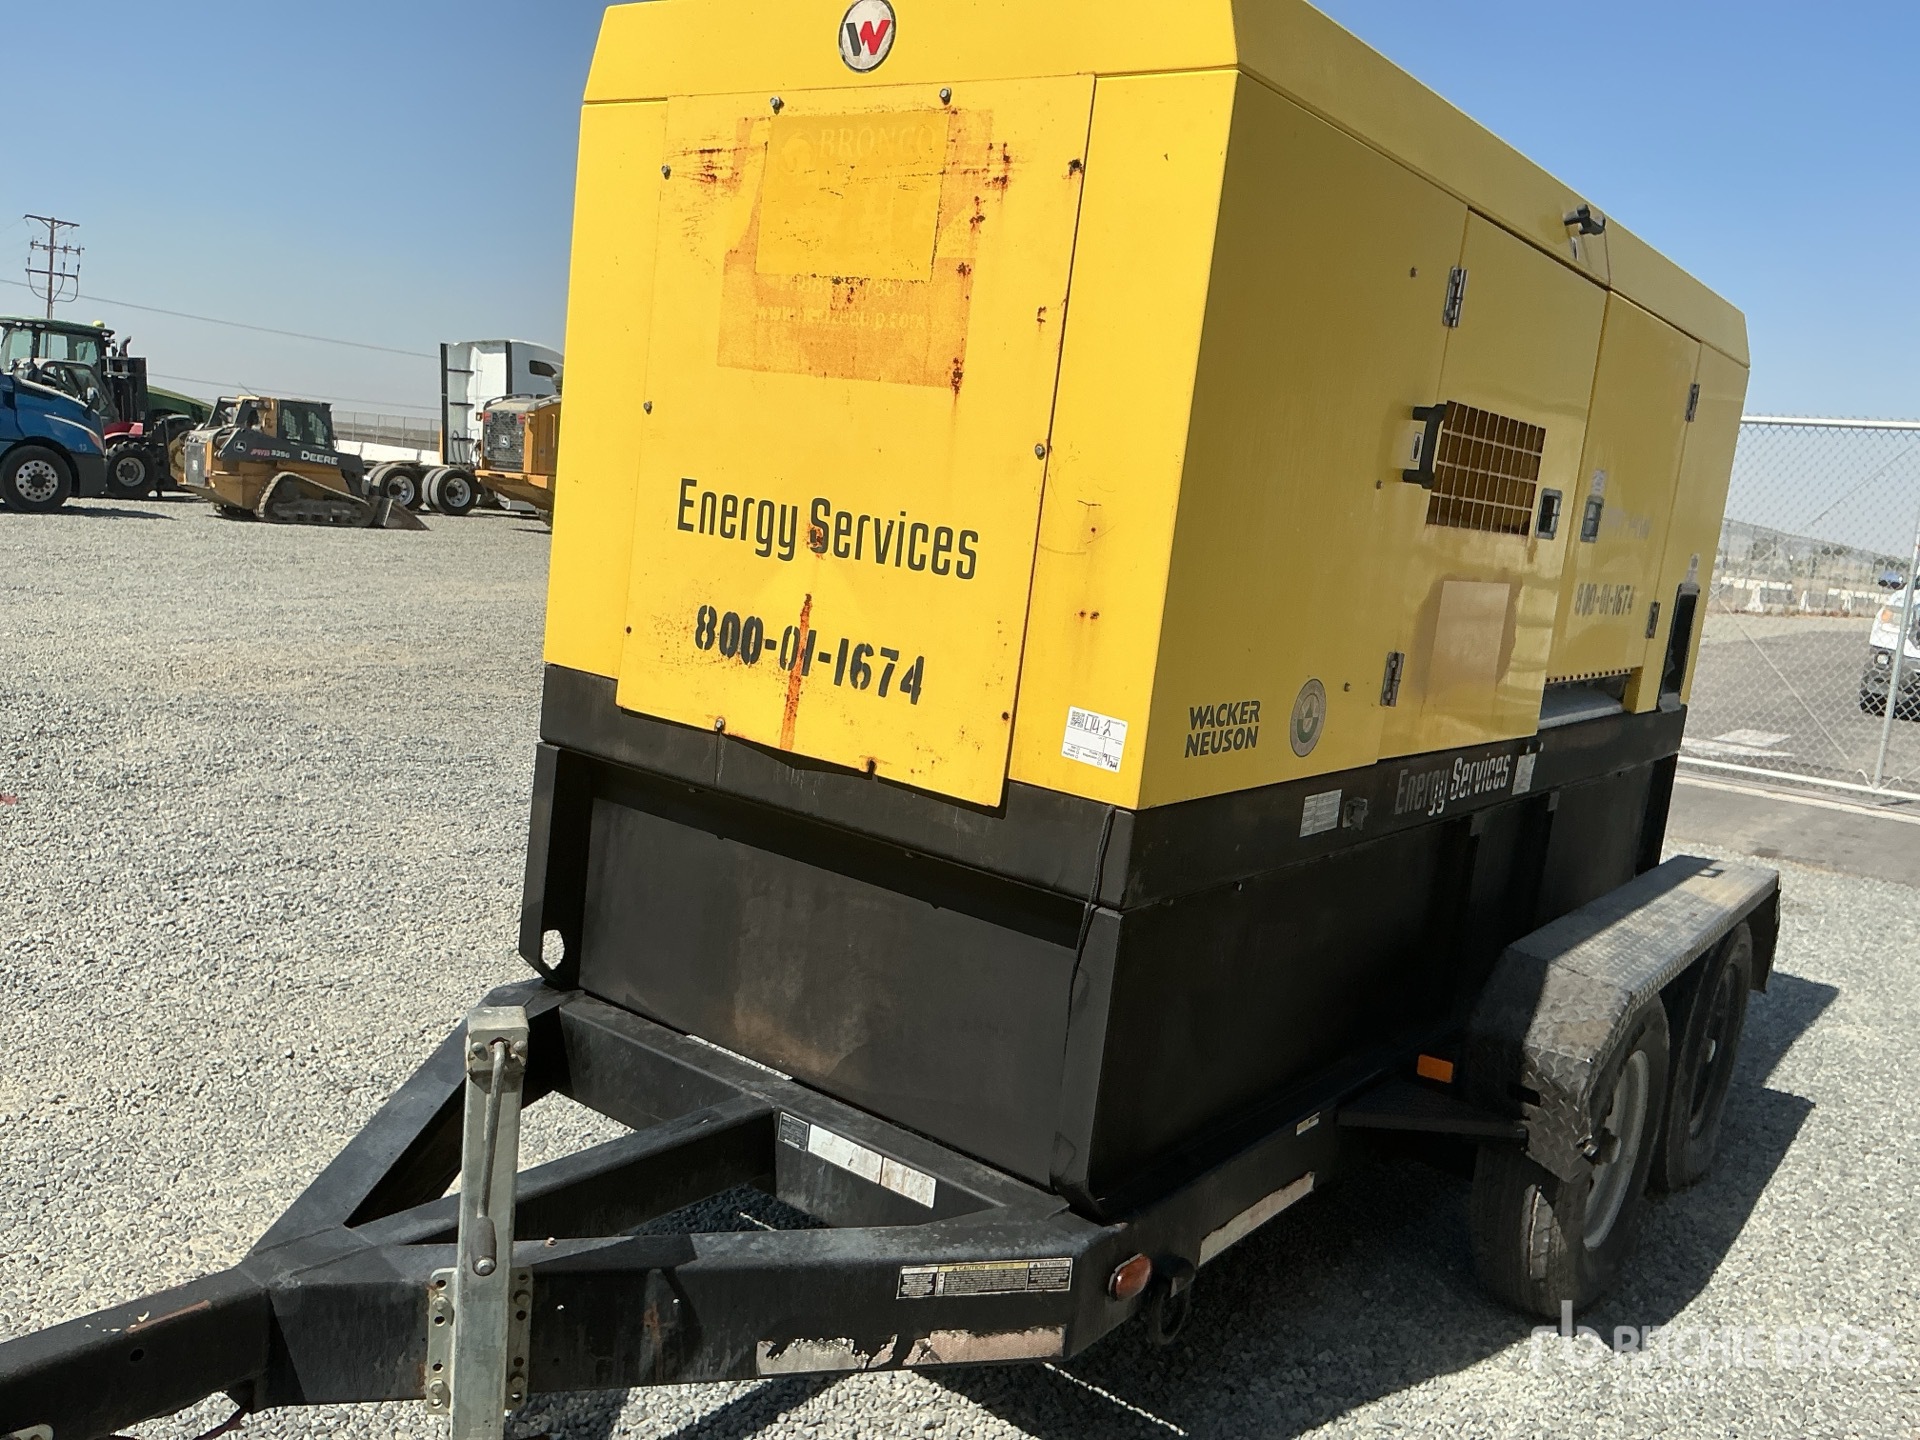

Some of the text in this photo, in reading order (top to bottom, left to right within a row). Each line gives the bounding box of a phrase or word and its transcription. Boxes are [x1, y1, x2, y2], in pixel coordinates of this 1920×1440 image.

[818, 125, 936, 158] BRONCO
[301, 450, 339, 466] DEERE
[676, 477, 979, 580] Energy Services
[1574, 582, 1636, 617] 800-01-1674
[694, 604, 925, 706] 800-01-1674
[1188, 700, 1261, 731] WACKER
[1184, 725, 1259, 759] NEUSON
[1393, 767, 1450, 817] Energy
[1450, 752, 1512, 801] Services
